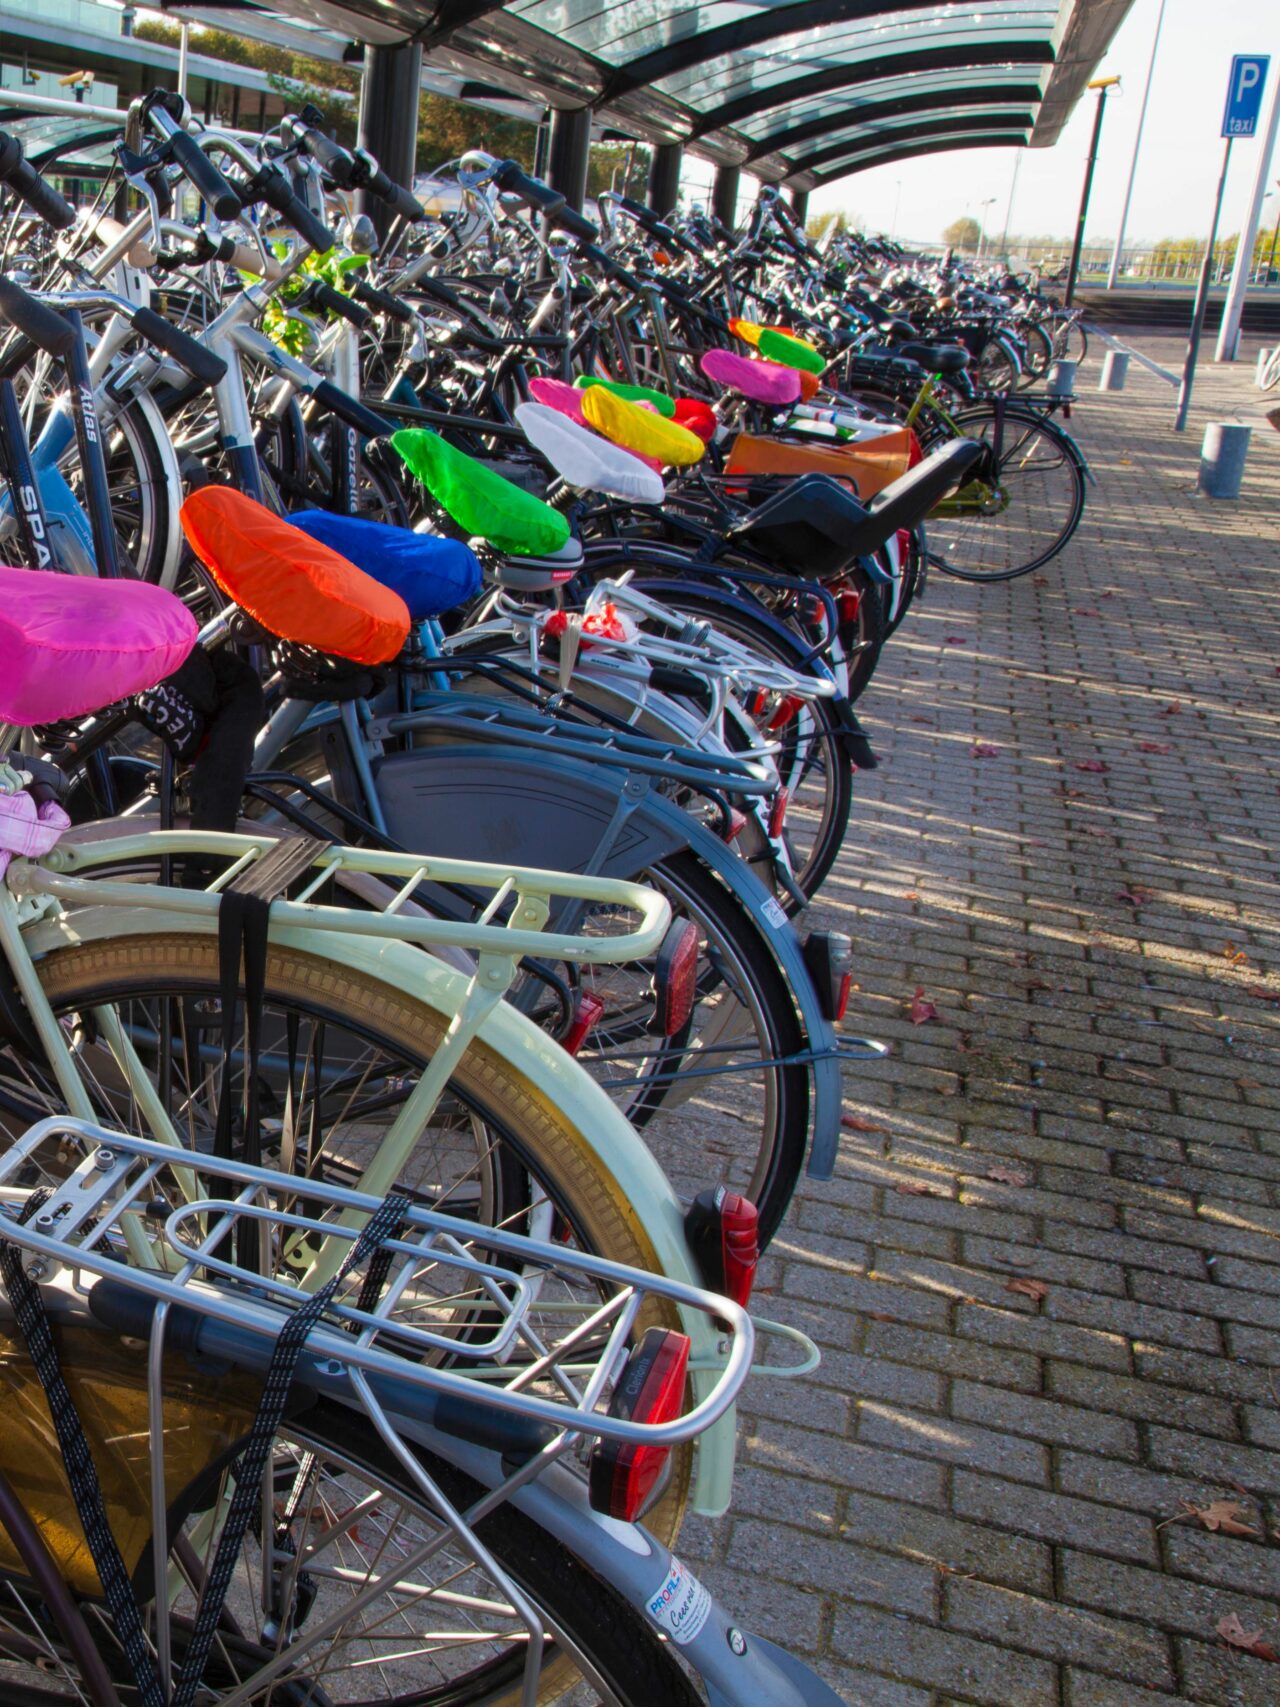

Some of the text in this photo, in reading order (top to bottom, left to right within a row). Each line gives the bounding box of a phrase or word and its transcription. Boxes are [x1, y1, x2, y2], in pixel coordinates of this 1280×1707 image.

[1236, 62, 1260, 102] P
[1229, 117, 1255, 132] taxi
[78, 384, 98, 443] Atlas
[347, 426, 359, 514] Gazelle
